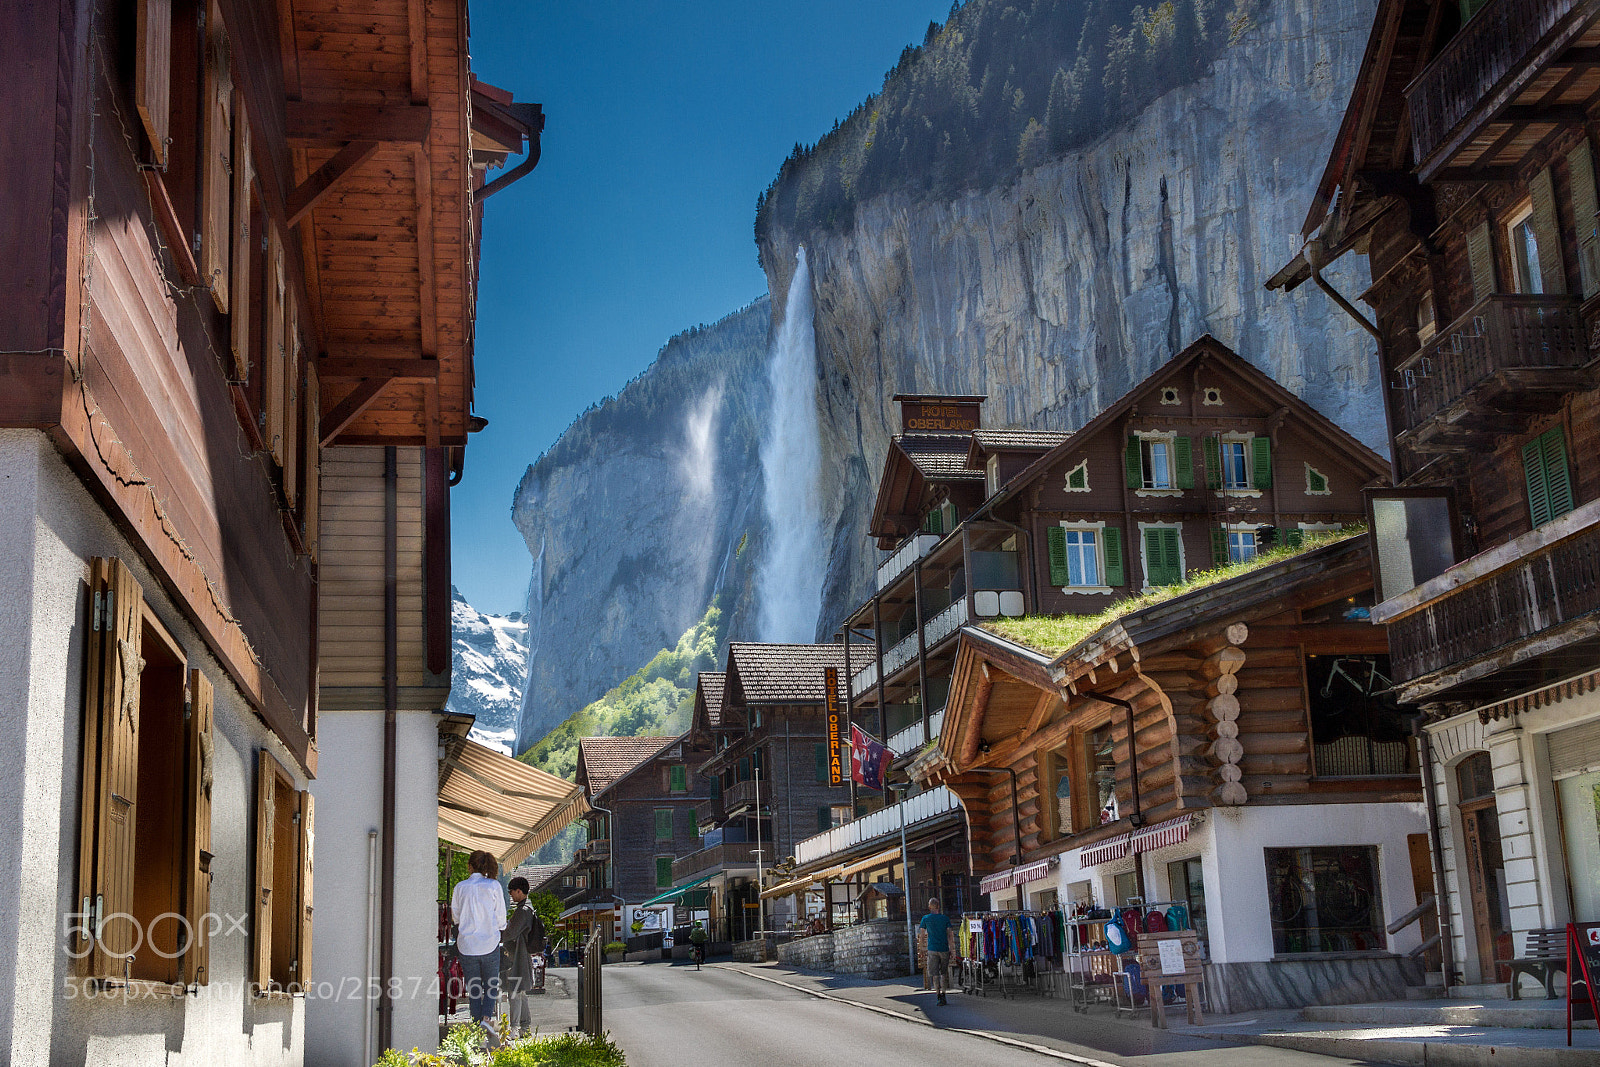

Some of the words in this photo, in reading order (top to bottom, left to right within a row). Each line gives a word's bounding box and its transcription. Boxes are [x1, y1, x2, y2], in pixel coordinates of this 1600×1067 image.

[908, 418, 975, 430] OBERLAND
[921, 405, 962, 418] HOTEL
[826, 669, 837, 711] HOTEL
[829, 714, 841, 784] OBERLAND
